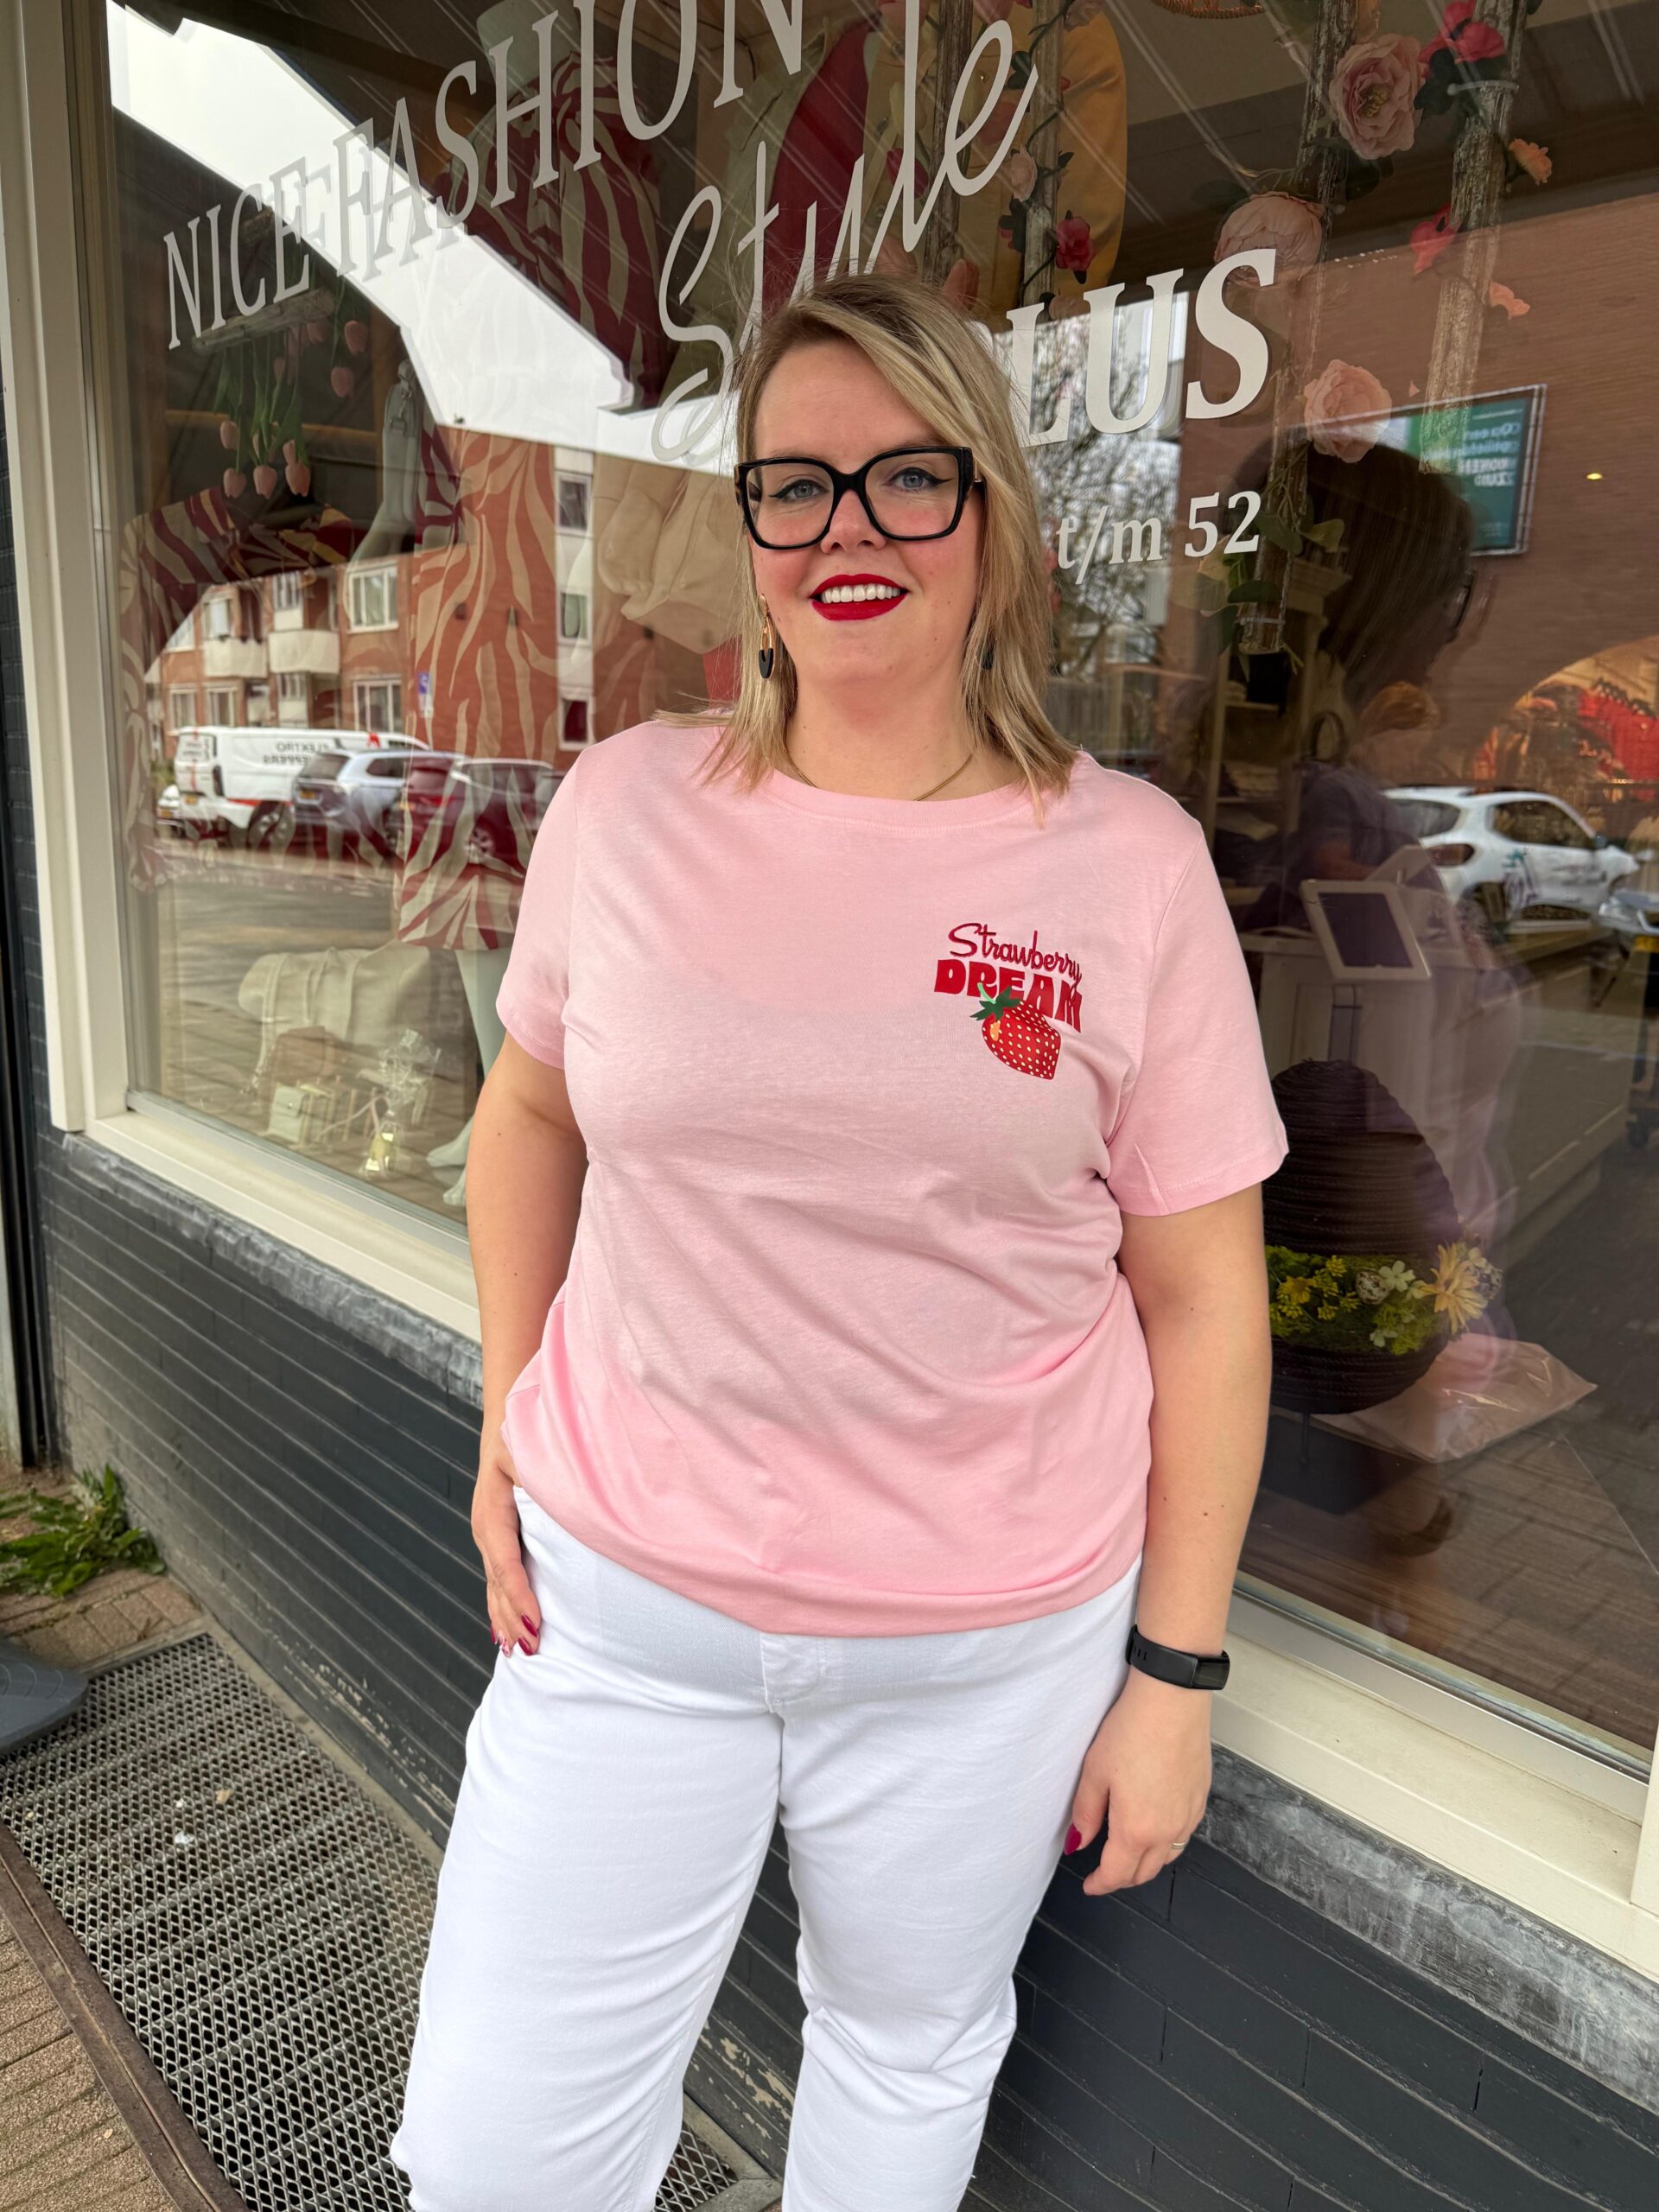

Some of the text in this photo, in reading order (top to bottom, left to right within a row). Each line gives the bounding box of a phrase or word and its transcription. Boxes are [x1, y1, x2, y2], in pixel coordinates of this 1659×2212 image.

[163, 156, 309, 350] NICE
[966, 249, 1276, 448] LUS
[1056, 490, 1262, 586] t/m 52
[934, 958, 1083, 1033] DREAM
[948, 922, 1082, 1007] Strawberry
